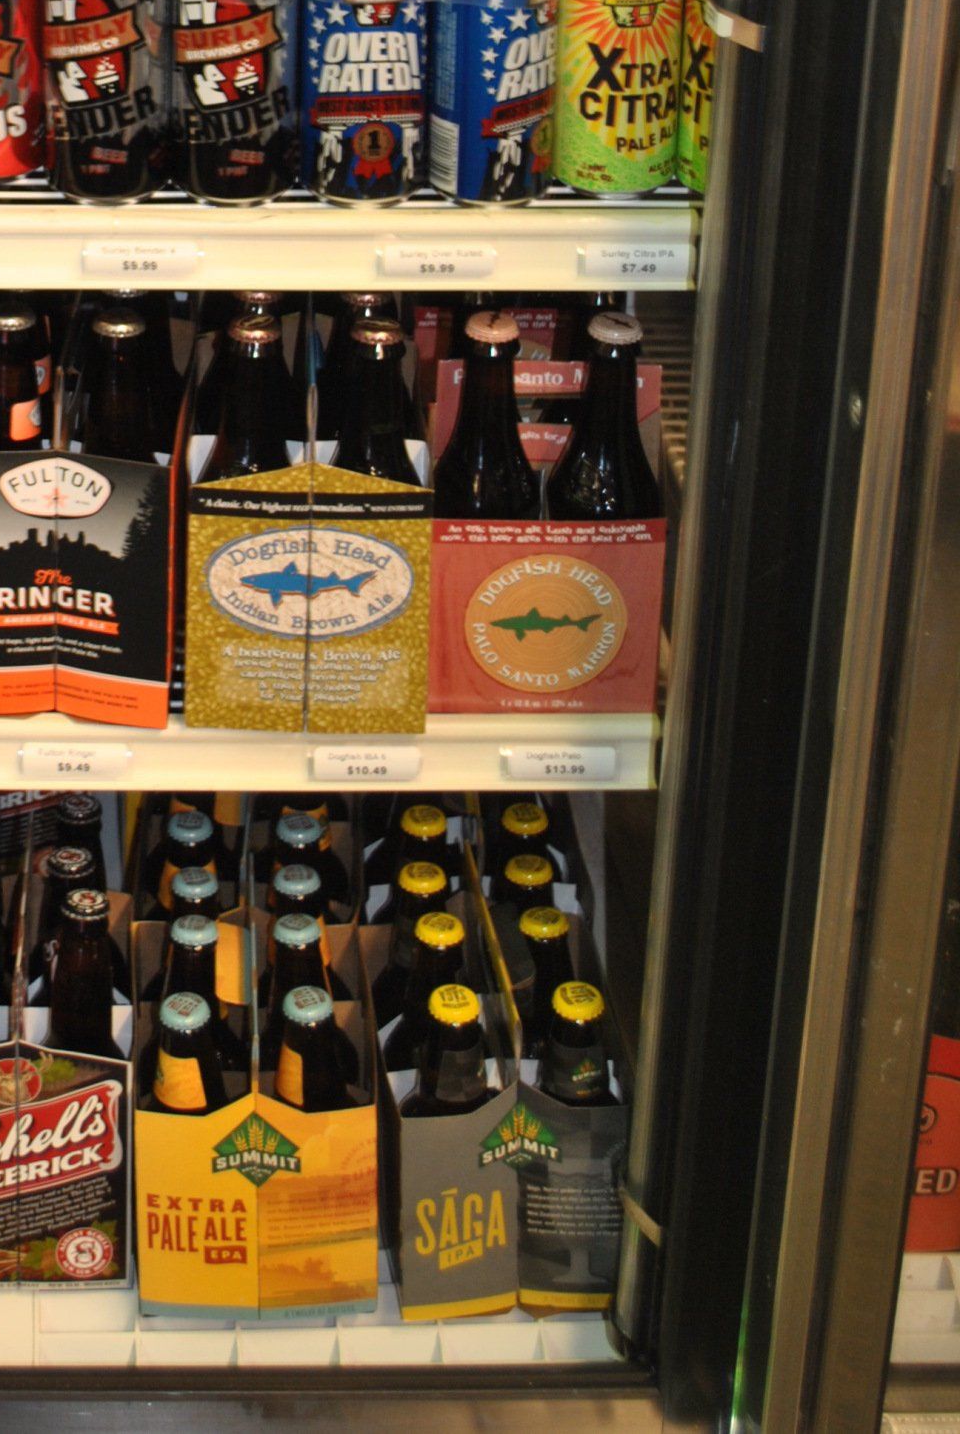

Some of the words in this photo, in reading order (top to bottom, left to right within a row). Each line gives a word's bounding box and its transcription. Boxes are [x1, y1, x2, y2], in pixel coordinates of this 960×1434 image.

[176, 14, 271, 50] SURLY
[184, 43, 240, 60] BREWING
[323, 31, 408, 63] OVER
[503, 26, 556, 71] OVE
[317, 63, 422, 94] RATED!
[495, 56, 556, 103] RATE
[54, 84, 156, 140] ENDER
[189, 85, 290, 143] ENDER
[579, 89, 677, 127] CITRA
[367, 134, 382, 151] 1
[615, 134, 656, 154] PALE
[601, 249, 632, 260] Surley
[634, 249, 657, 259] Citra
[657, 249, 675, 259] IPA
[122, 260, 158, 271] $9.99
[419, 263, 455, 274] $9.99
[621, 262, 657, 274] $7.49
[7, 465, 105, 498] FULTON
[244, 501, 260, 511] Our
[261, 499, 292, 514] highest
[448, 524, 462, 534] An
[488, 524, 522, 534] brown
[545, 524, 573, 534] Lush
[575, 524, 595, 534] and
[598, 524, 646, 535] enjoyable
[468, 533, 488, 543] this
[490, 533, 513, 543] beer
[545, 533, 569, 543] with
[571, 533, 588, 543] the
[616, 533, 628, 543] of
[229, 536, 318, 568] Dogfish
[332, 537, 392, 571] Head
[34, 568, 73, 586] The
[477, 560, 562, 608] DOGFISH
[567, 562, 614, 608] HEAD
[223, 588, 280, 627] Indian
[291, 610, 357, 631] Brown
[366, 590, 395, 618] Ale
[3, 614, 55, 625] AMERICAN
[65, 616, 86, 628] PALE
[87, 619, 105, 630] ALE
[222, 646, 235, 658] A
[238, 646, 318, 661] boisterous
[322, 648, 372, 661] Brown
[378, 648, 401, 661] Ale
[472, 621, 500, 667] PALO
[497, 662, 560, 688] SANTO
[566, 621, 616, 681] MARRON
[327, 752, 361, 763] Dogfish
[526, 751, 560, 762] Dogfish
[561, 751, 582, 761] Palo
[57, 762, 91, 773] $9.49
[347, 765, 387, 776] $10.49
[544, 764, 586, 775] $13.99
[215, 1148, 300, 1171] SUMMIT
[481, 1139, 559, 1165] SUMMIT
[146, 1193, 247, 1213] EXTRA
[148, 1212, 199, 1253] PALE
[203, 1216, 247, 1243] ALE
[209, 1248, 243, 1261] EPA
[445, 1245, 476, 1265] IPA
